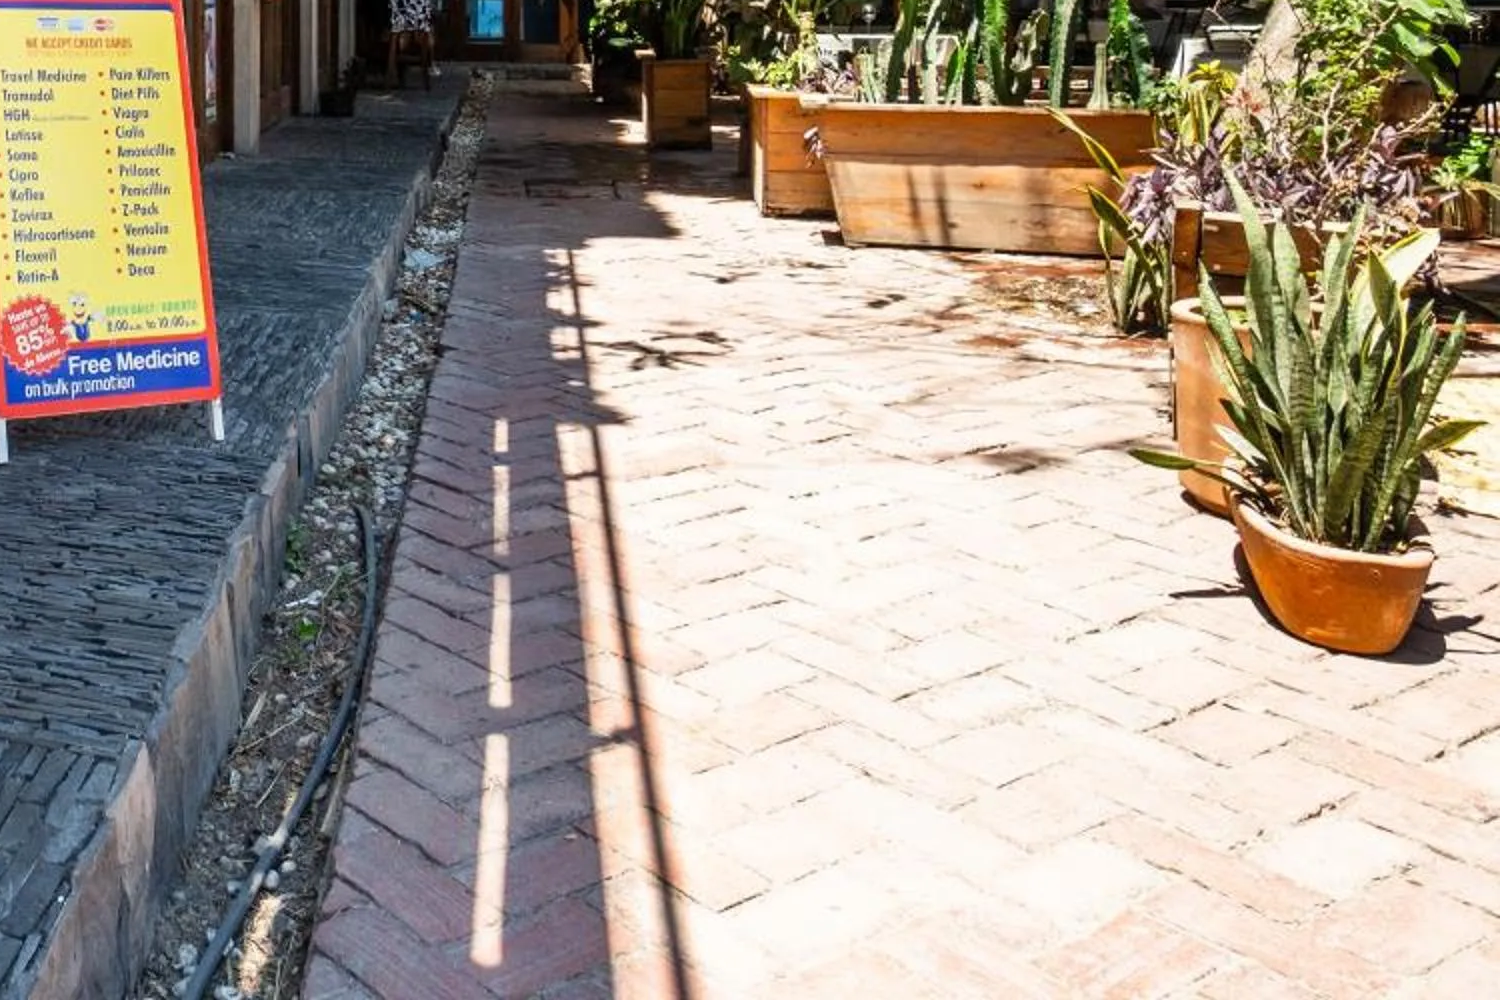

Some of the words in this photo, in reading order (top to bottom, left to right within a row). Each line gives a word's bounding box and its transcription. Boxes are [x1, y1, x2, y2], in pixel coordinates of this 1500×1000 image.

[41, 37, 72, 49] ACCEPT
[73, 37, 103, 49] CREDIT
[105, 37, 133, 50] CARDS
[0, 69, 33, 83] Travel
[37, 69, 87, 82] Medicine
[109, 68, 133, 81] Pain
[135, 67, 171, 81] Killers
[2, 88, 54, 102] Tramadol
[111, 87, 133, 100] Diet
[136, 87, 160, 100] Pills
[3, 109, 30, 121] HGH
[112, 106, 149, 122] Viagra
[5, 129, 43, 142] Latisse
[115, 125, 145, 138] Cialis
[7, 149, 38, 161] Soma
[116, 144, 176, 157] Amoxicillin
[8, 168, 39, 184] Cipro
[119, 163, 161, 177] Prilosec
[120, 182, 171, 197] Penicillin
[11, 208, 53, 222] Zovirax
[122, 202, 159, 217] Z-Pack
[13, 227, 96, 243] Hidrocortisone
[124, 222, 169, 237] Ventolin
[15, 248, 57, 264] Flexeril
[126, 243, 168, 257] Nexium
[17, 269, 59, 285] Retin-A
[127, 263, 155, 277] Deca
[15, 324, 55, 355] 85%
[67, 354, 112, 376] Free
[117, 347, 200, 372] Medicine
[25, 385, 40, 398] on
[42, 377, 70, 398] bulk
[71, 374, 135, 399] promotion
